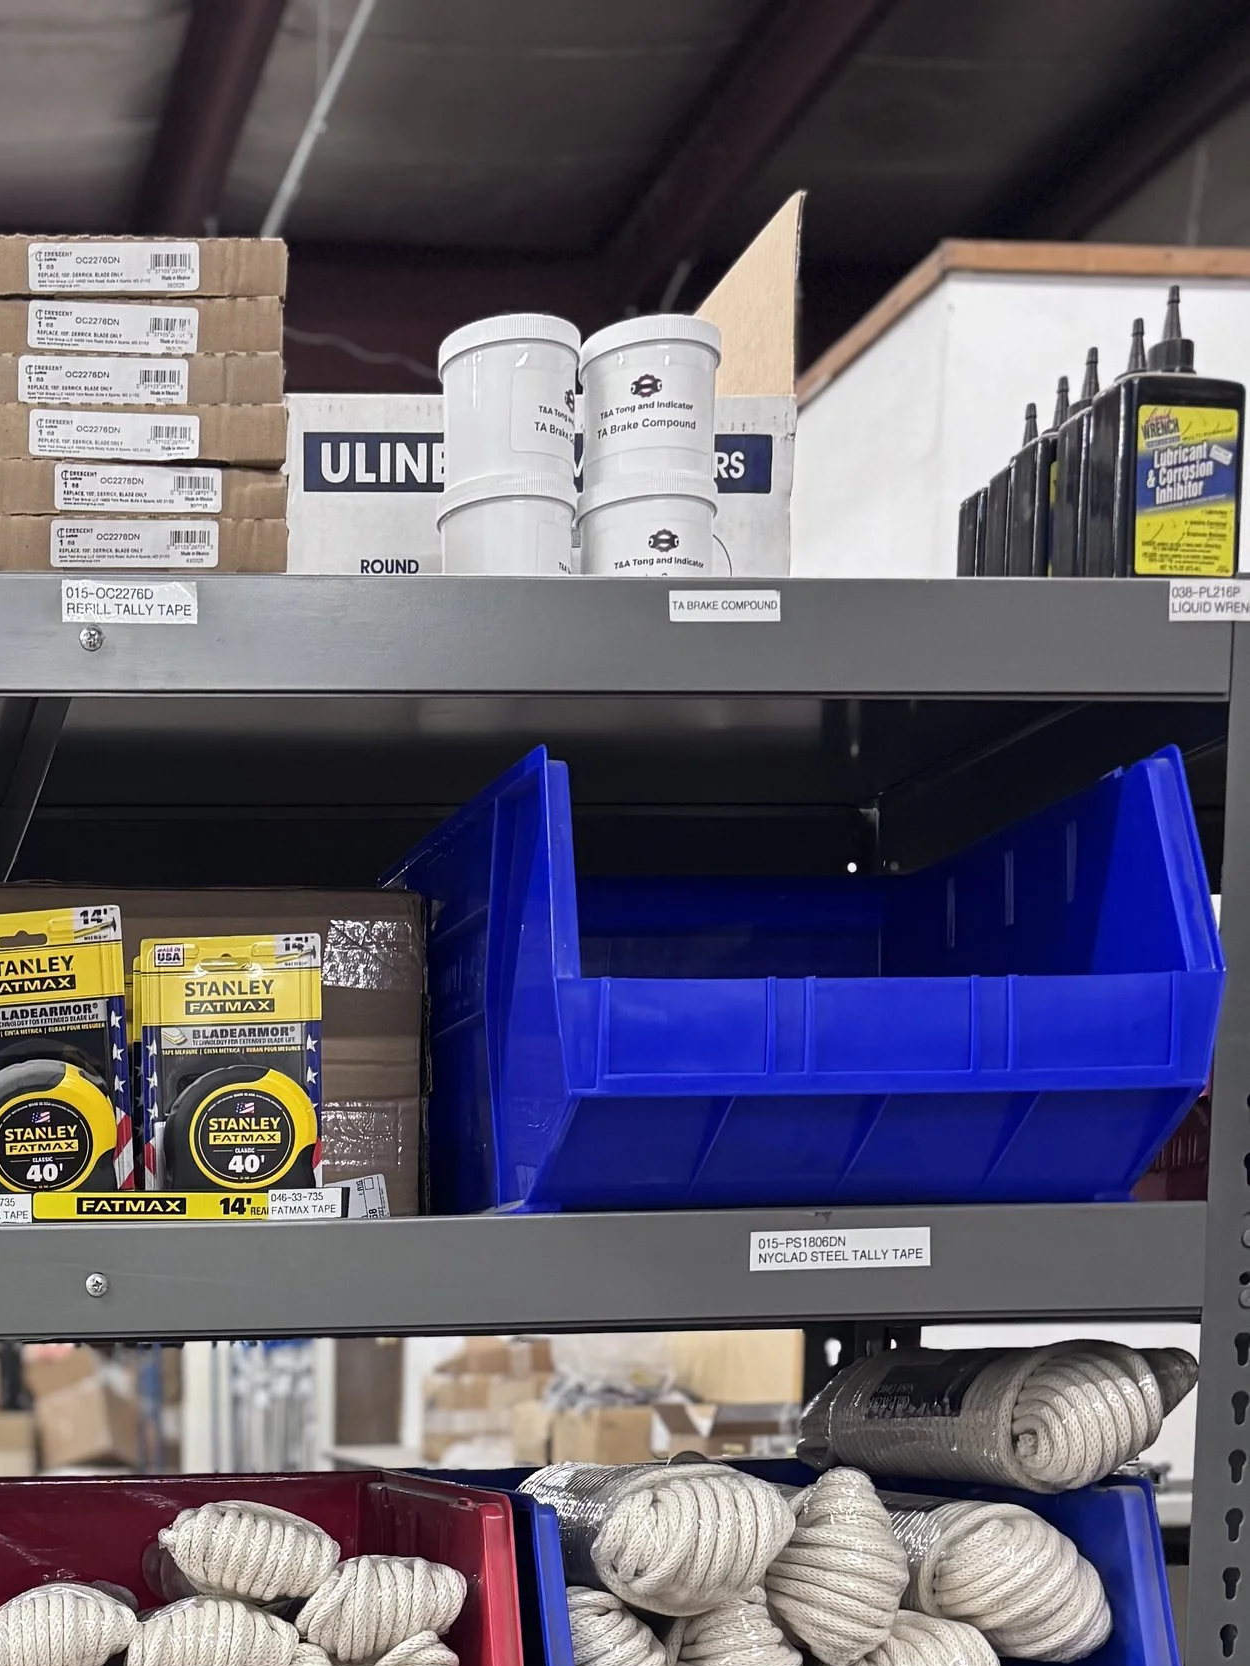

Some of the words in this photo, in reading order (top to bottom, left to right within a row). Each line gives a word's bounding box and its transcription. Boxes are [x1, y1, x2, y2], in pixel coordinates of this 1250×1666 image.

[616, 406, 635, 417] Tong
[638, 402, 654, 411] and
[657, 401, 693, 411] Indicator
[597, 429, 608, 439] TA
[611, 422, 638, 434] Brake
[642, 418, 696, 431] Compound
[1154, 441, 1208, 468] Lubricant
[1147, 470, 1155, 488] &
[1159, 461, 1214, 486] Corrosion
[1156, 481, 1204, 504] Inhibitor
[361, 560, 419, 574] ROUND
[66, 588, 153, 600] 015-OC2276D
[1172, 587, 1240, 599] 038-PL216P
[67, 604, 111, 615] REFILL
[115, 604, 154, 616] TALLY
[157, 605, 191, 616] TAPE
[672, 601, 684, 610] TA
[686, 600, 718, 610] BRAKE
[721, 600, 777, 610] COMPOUND
[1172, 602, 1211, 613] LIQUID
[1214, 602, 1250, 613] WREN
[185, 979, 274, 997] STANLEY
[190, 1000, 270, 1012] FATMAX
[209, 1117, 280, 1130] STANLEY
[5, 1125, 78, 1140] STANLEY
[213, 1133, 276, 1142] FATMAX
[10, 1143, 76, 1153] FATMAX
[228, 1155, 264, 1172] 40'
[27, 1163, 63, 1182] 40'
[271, 1191, 323, 1201] 046-33-735
[82, 1199, 181, 1213] FATMAX
[271, 1204, 308, 1215] FATMAX
[310, 1203, 336, 1213] TAPE
[4, 1209, 28, 1220] TAPE
[758, 1236, 845, 1249] 015-PS1806DN
[758, 1252, 807, 1263] NYCLAD
[811, 1251, 848, 1261] STEEL
[852, 1249, 888, 1260] TALLY
[892, 1248, 923, 1259] TAPE
